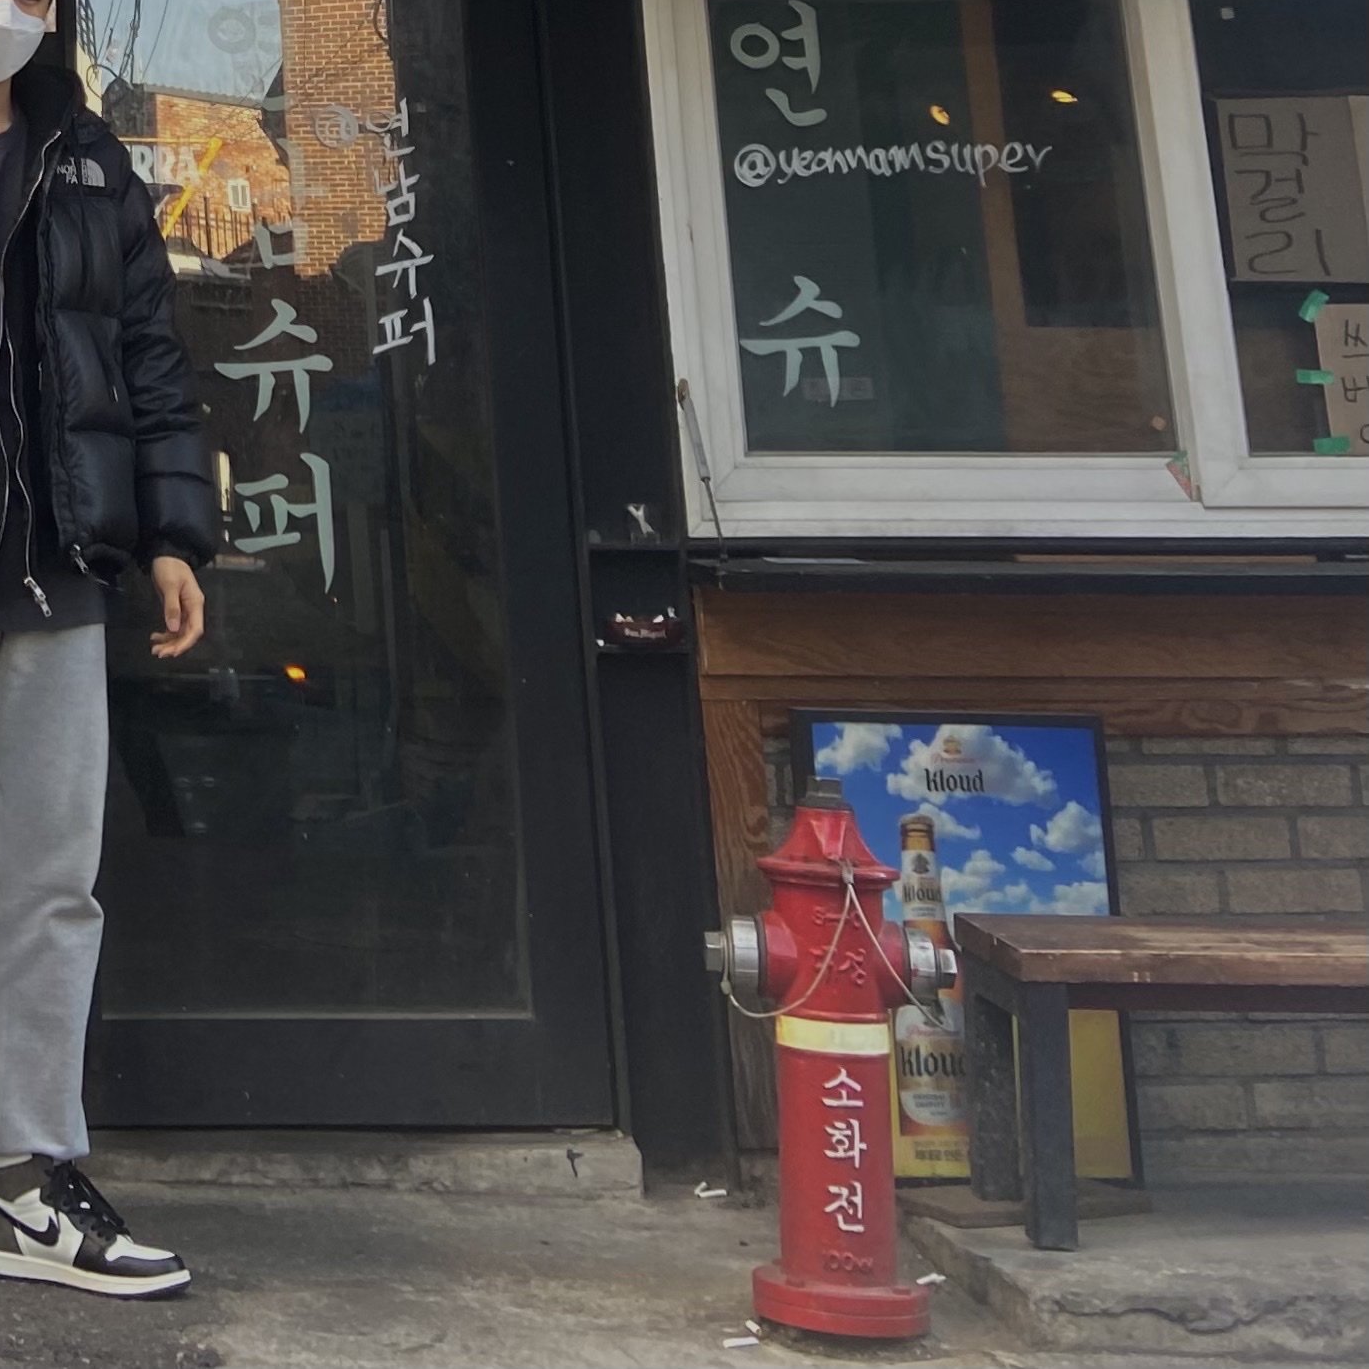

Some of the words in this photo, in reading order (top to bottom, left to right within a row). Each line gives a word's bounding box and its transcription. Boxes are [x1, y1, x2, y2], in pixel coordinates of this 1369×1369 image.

[1228, 112, 1331, 277] 막걸리
[739, 275, 861, 408] 슈
[821, 1066, 868, 1233] 소화전
